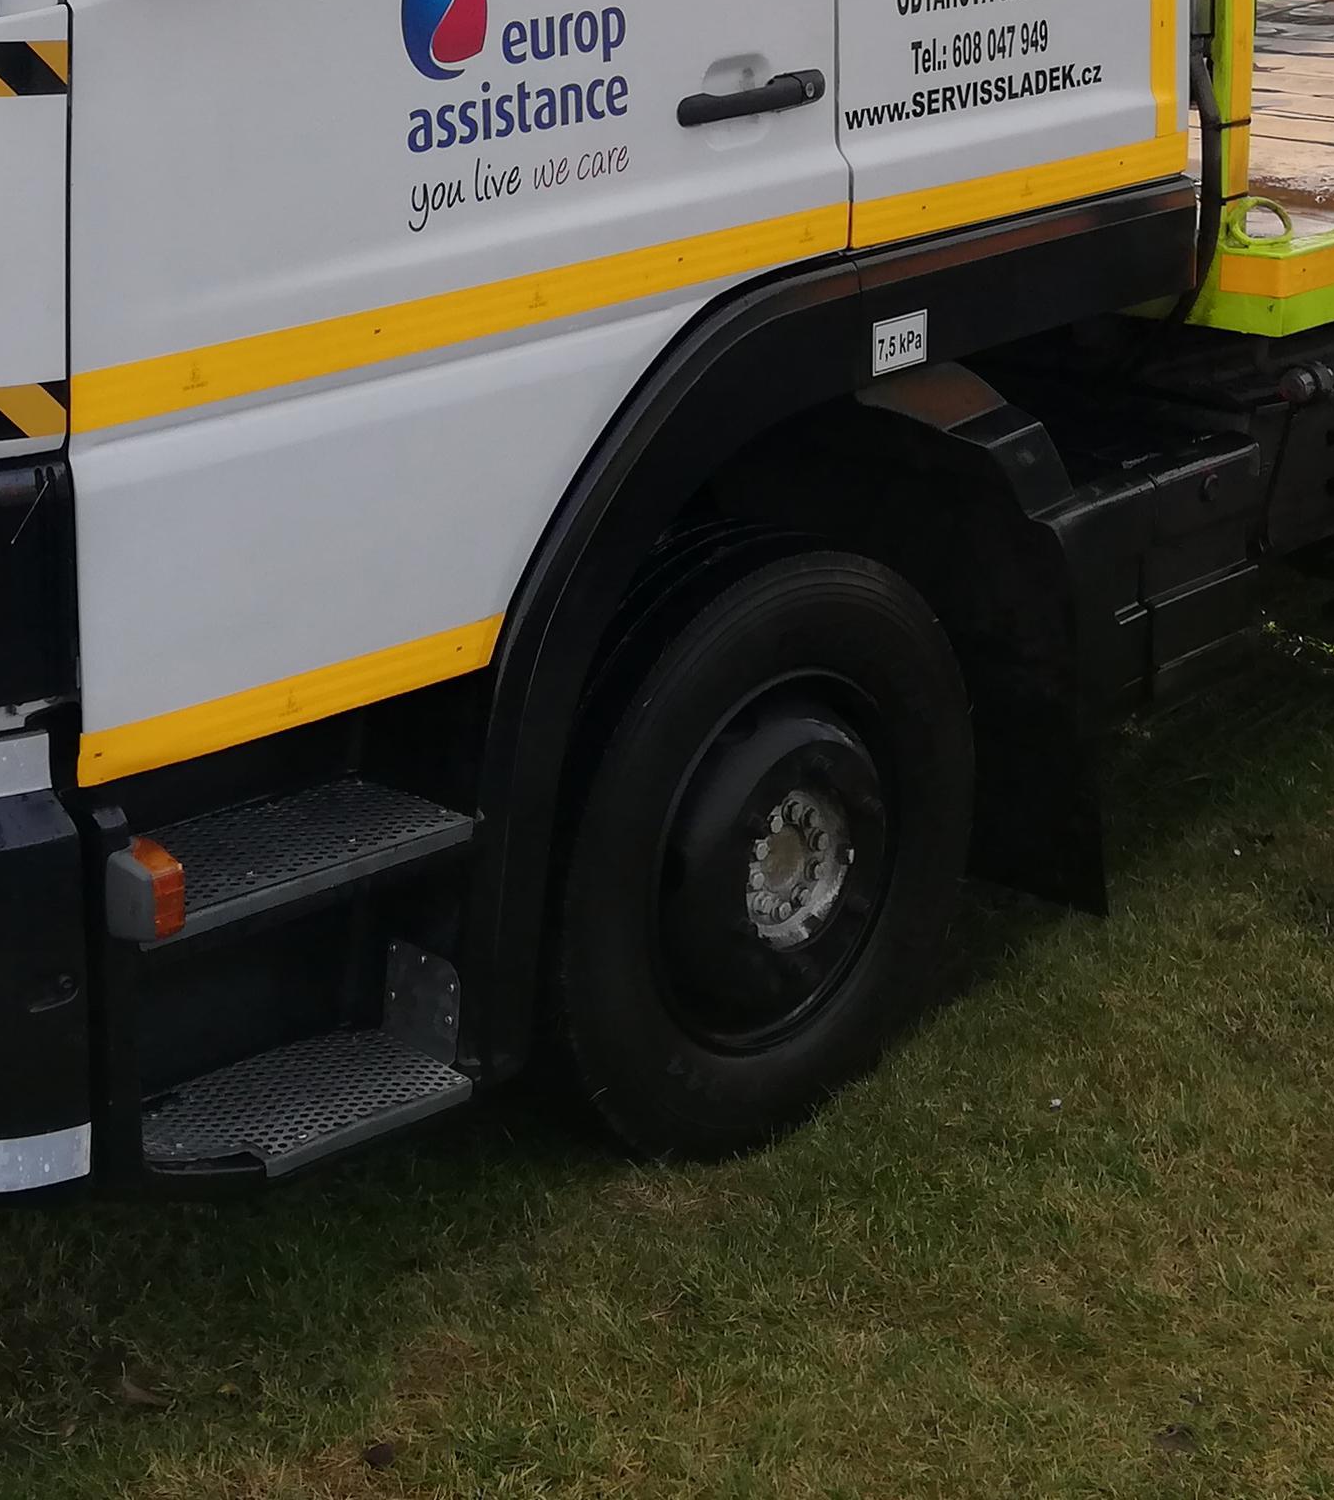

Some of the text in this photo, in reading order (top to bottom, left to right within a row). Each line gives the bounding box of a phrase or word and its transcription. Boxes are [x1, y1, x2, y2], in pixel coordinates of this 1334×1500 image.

[501, 6, 627, 64] europ
[911, 19, 1048, 74] Tel.: 608 047 949
[407, 75, 629, 153] assistance
[845, 63, 1102, 130] www.SERVISSLADEK.cz
[408, 145, 629, 232] you live we care
[878, 330, 922, 362] 7,5 kPa
